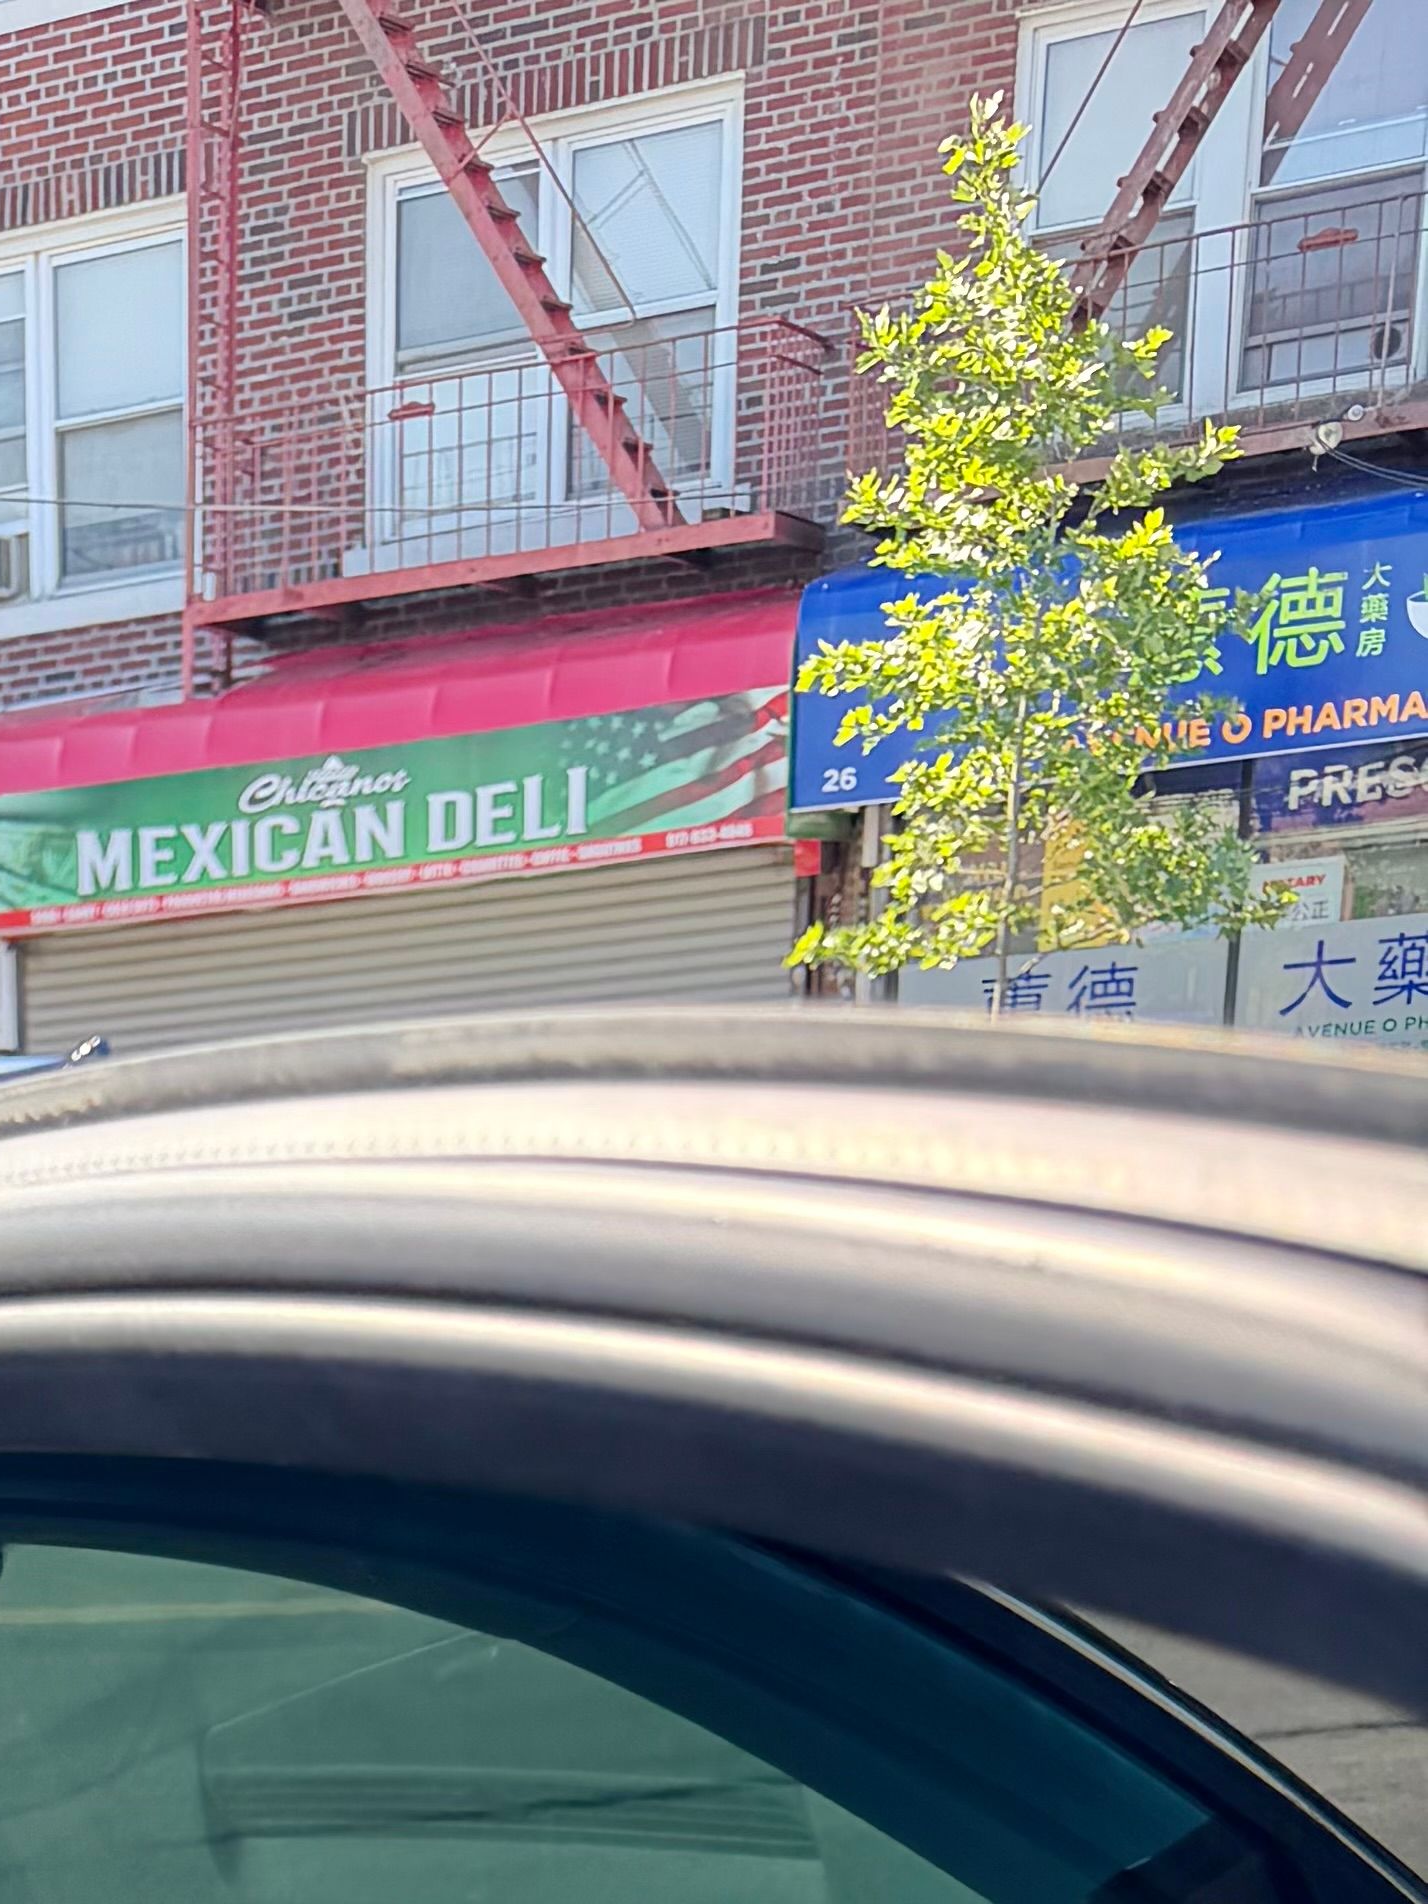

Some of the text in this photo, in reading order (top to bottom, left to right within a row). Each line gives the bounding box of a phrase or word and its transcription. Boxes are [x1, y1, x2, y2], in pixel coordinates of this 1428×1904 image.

[1355, 561, 1393, 658] 大藥房
[1061, 690, 1428, 756] ANUE O PHARMA
[821, 766, 857, 793] 26
[76, 766, 589, 897] MEXICAN DELI
[1262, 873, 1327, 895] TARY
[1295, 1019, 1376, 1038] AVENUE
[1383, 1018, 1398, 1033] O
